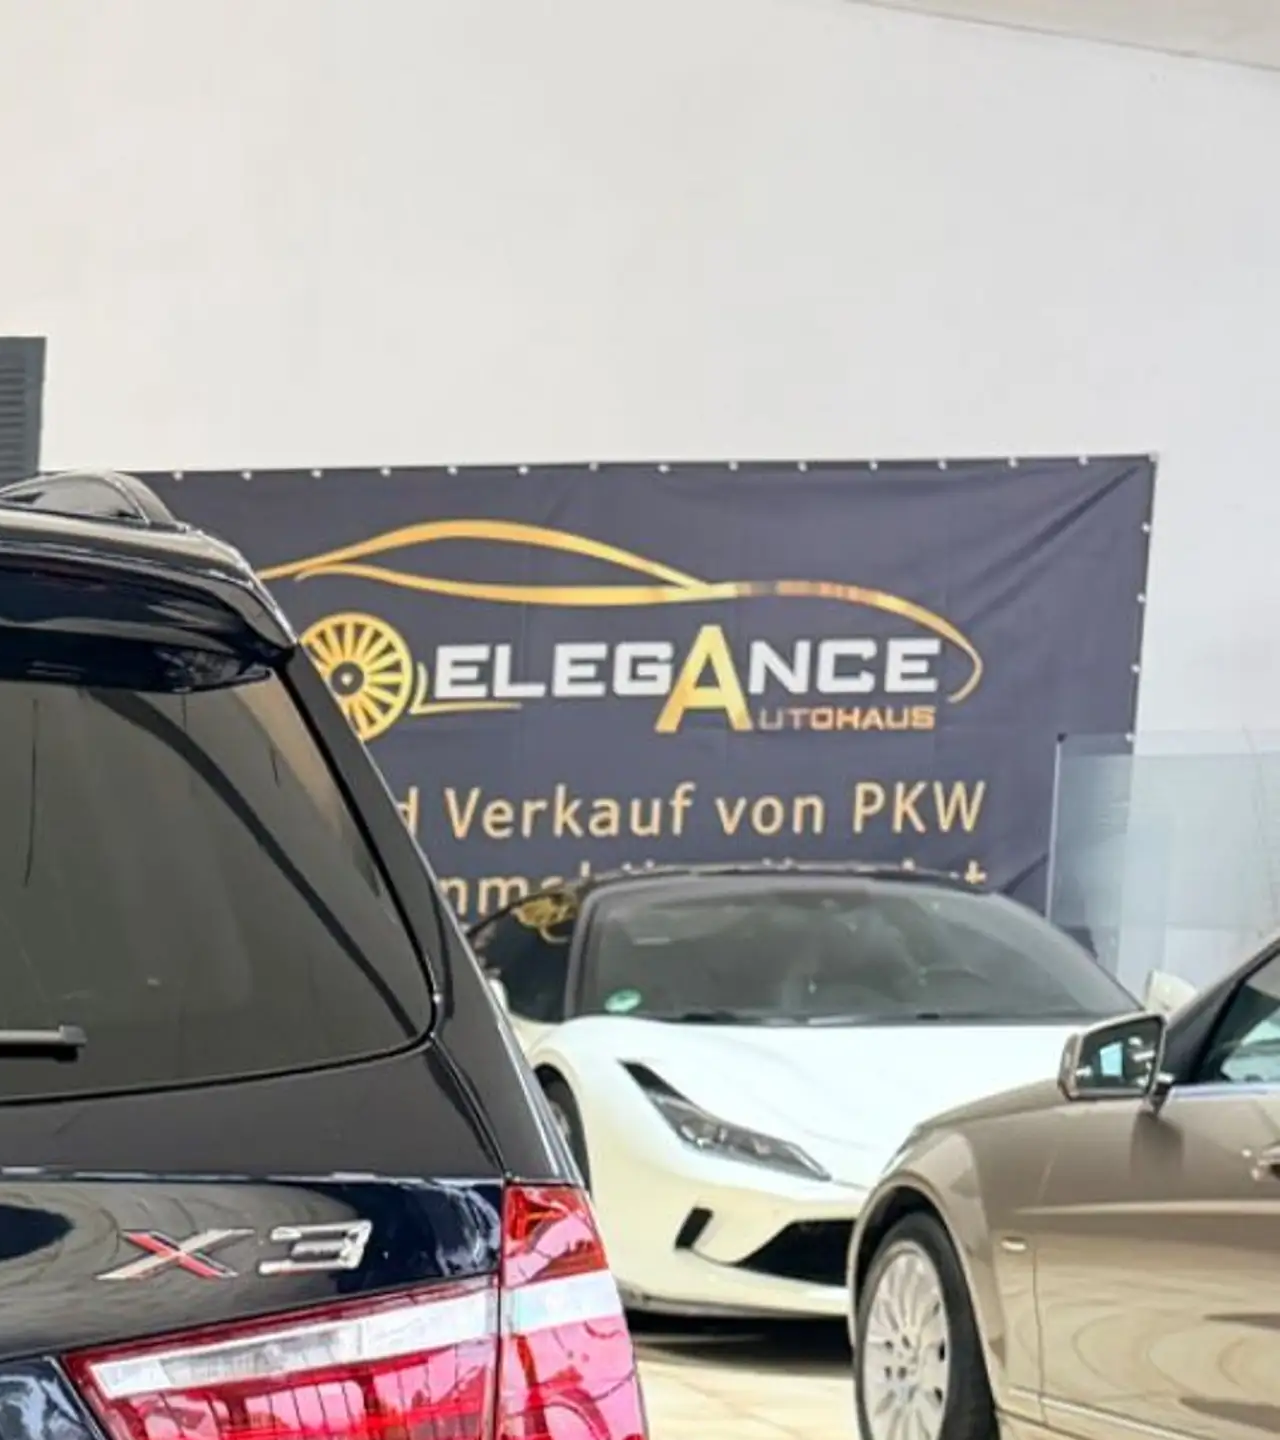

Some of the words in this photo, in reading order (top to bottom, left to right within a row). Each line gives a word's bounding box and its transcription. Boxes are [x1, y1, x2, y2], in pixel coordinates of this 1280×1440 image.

[434, 624, 941, 733] ELEGANCE
[445, 781, 697, 840] Verkauf
[715, 793, 826, 836] von
[852, 780, 988, 834] PKW
[94, 1218, 373, 1282] X3
